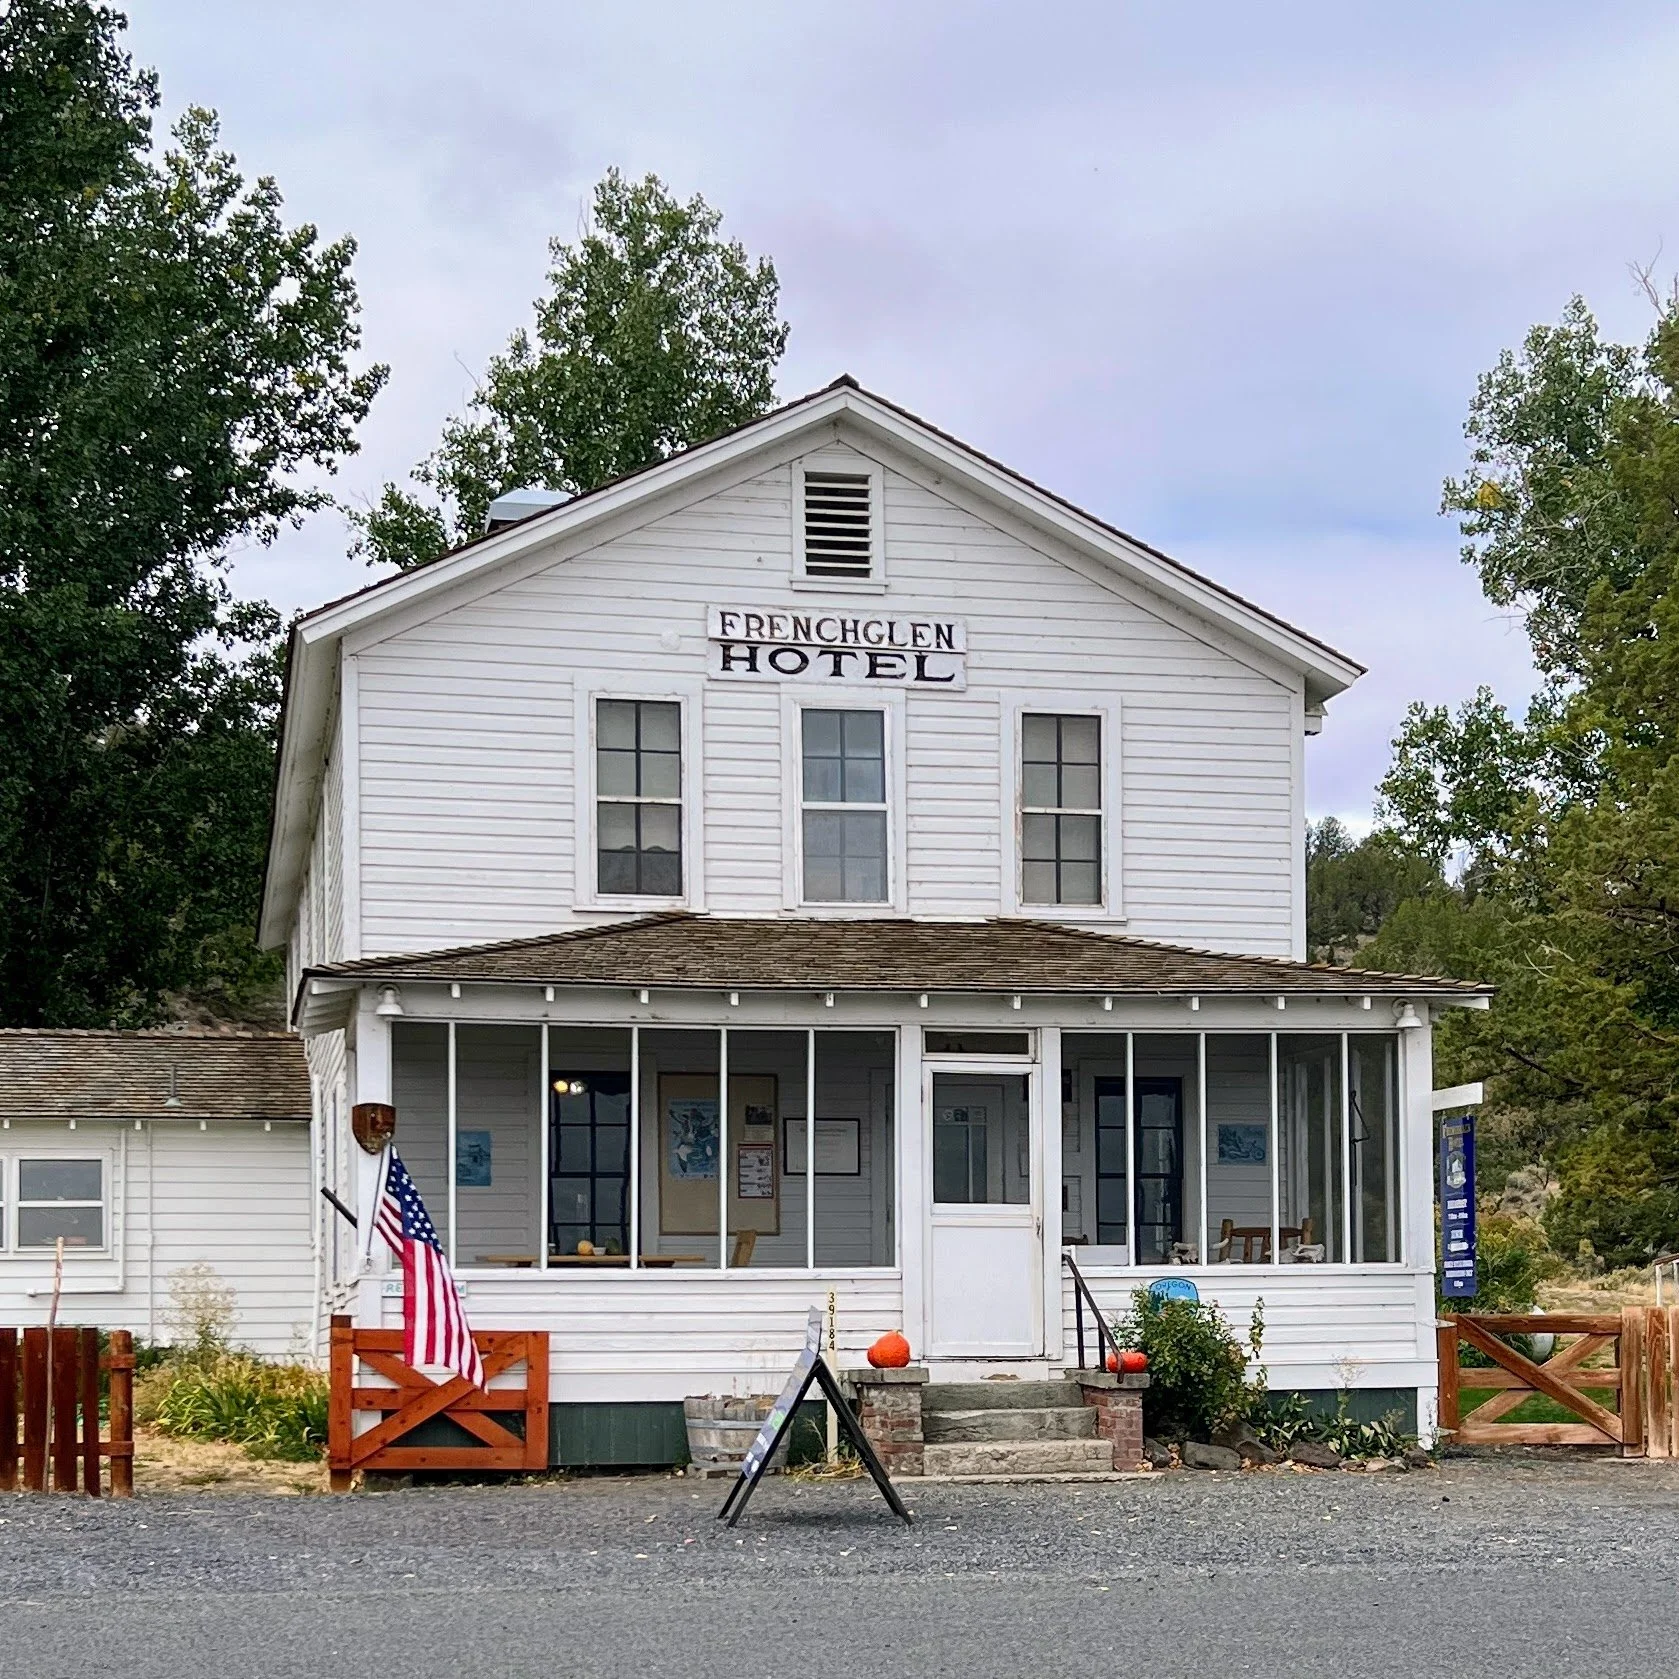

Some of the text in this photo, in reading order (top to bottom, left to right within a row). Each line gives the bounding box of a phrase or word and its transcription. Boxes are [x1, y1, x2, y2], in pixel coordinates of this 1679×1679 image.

[719, 611, 955, 649] FRENCHGLEN
[719, 644, 955, 682] HOTEL
[828, 1291, 836, 1352] 39184
